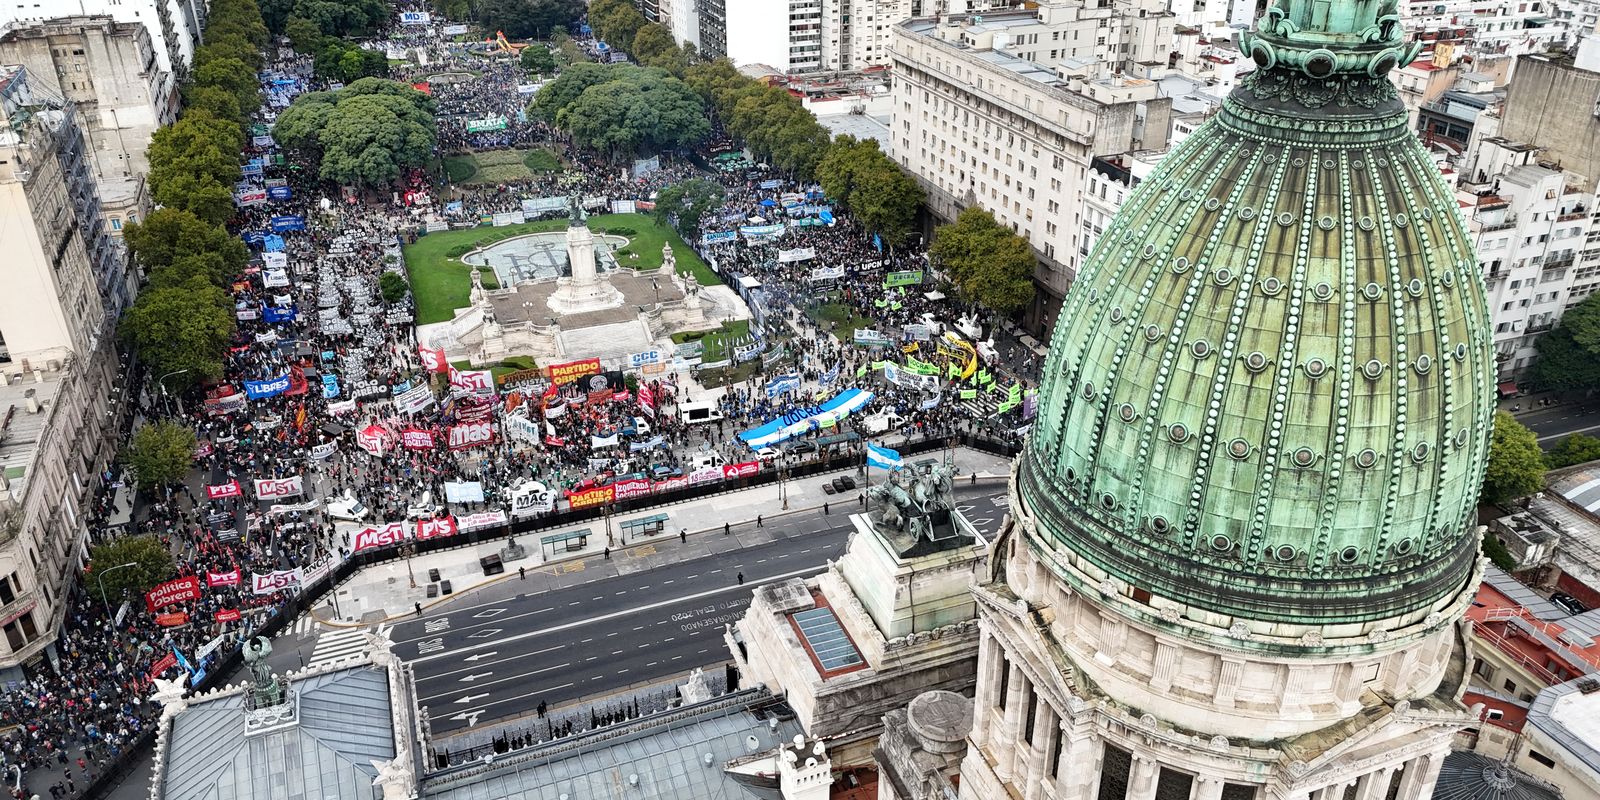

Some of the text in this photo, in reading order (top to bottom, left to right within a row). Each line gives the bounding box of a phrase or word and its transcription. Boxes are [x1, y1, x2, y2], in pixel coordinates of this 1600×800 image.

[861, 261, 882, 270] UPCN
[632, 351, 658, 362] CCC
[552, 362, 598, 376] PARTIDO
[255, 379, 289, 394] LIBRES
[353, 379, 378, 389] POLO
[782, 406, 826, 427] UOCRA
[209, 482, 237, 495] PTS
[615, 481, 649, 493] IZQUIERDA
[517, 493, 548, 506] MAC
[150, 581, 192, 601] Política
[153, 590, 194, 608] Obrera
